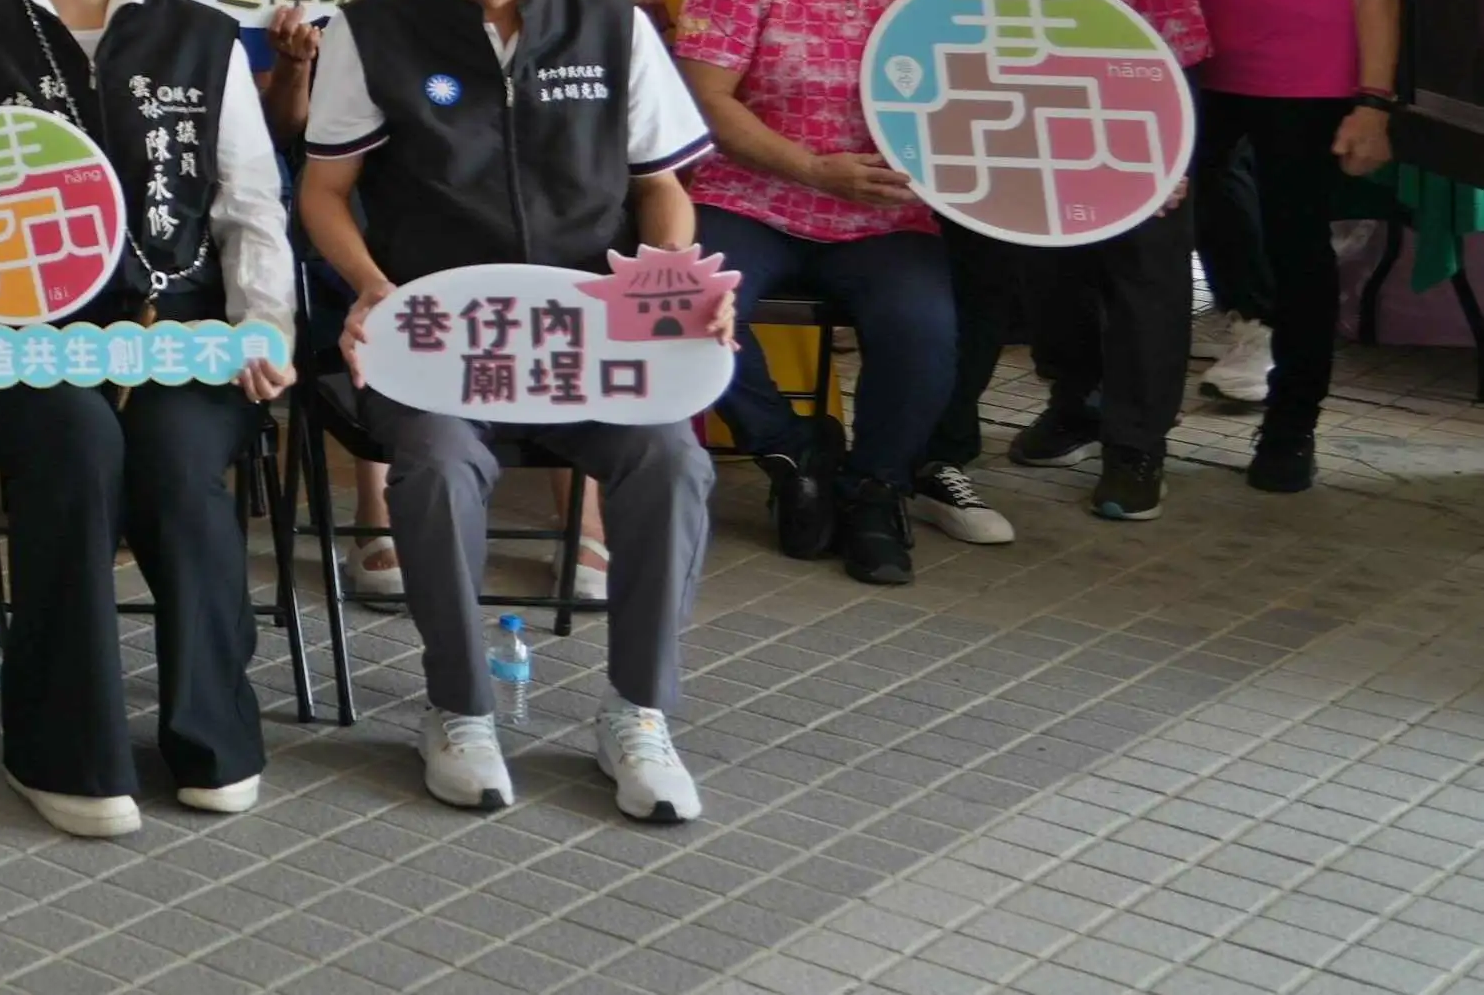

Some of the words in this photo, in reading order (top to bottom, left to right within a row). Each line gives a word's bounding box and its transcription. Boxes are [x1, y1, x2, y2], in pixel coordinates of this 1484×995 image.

[144, 127, 180, 240] 陳永修
[395, 295, 585, 353] 巷仔內
[460, 349, 650, 406] 廟埕口
